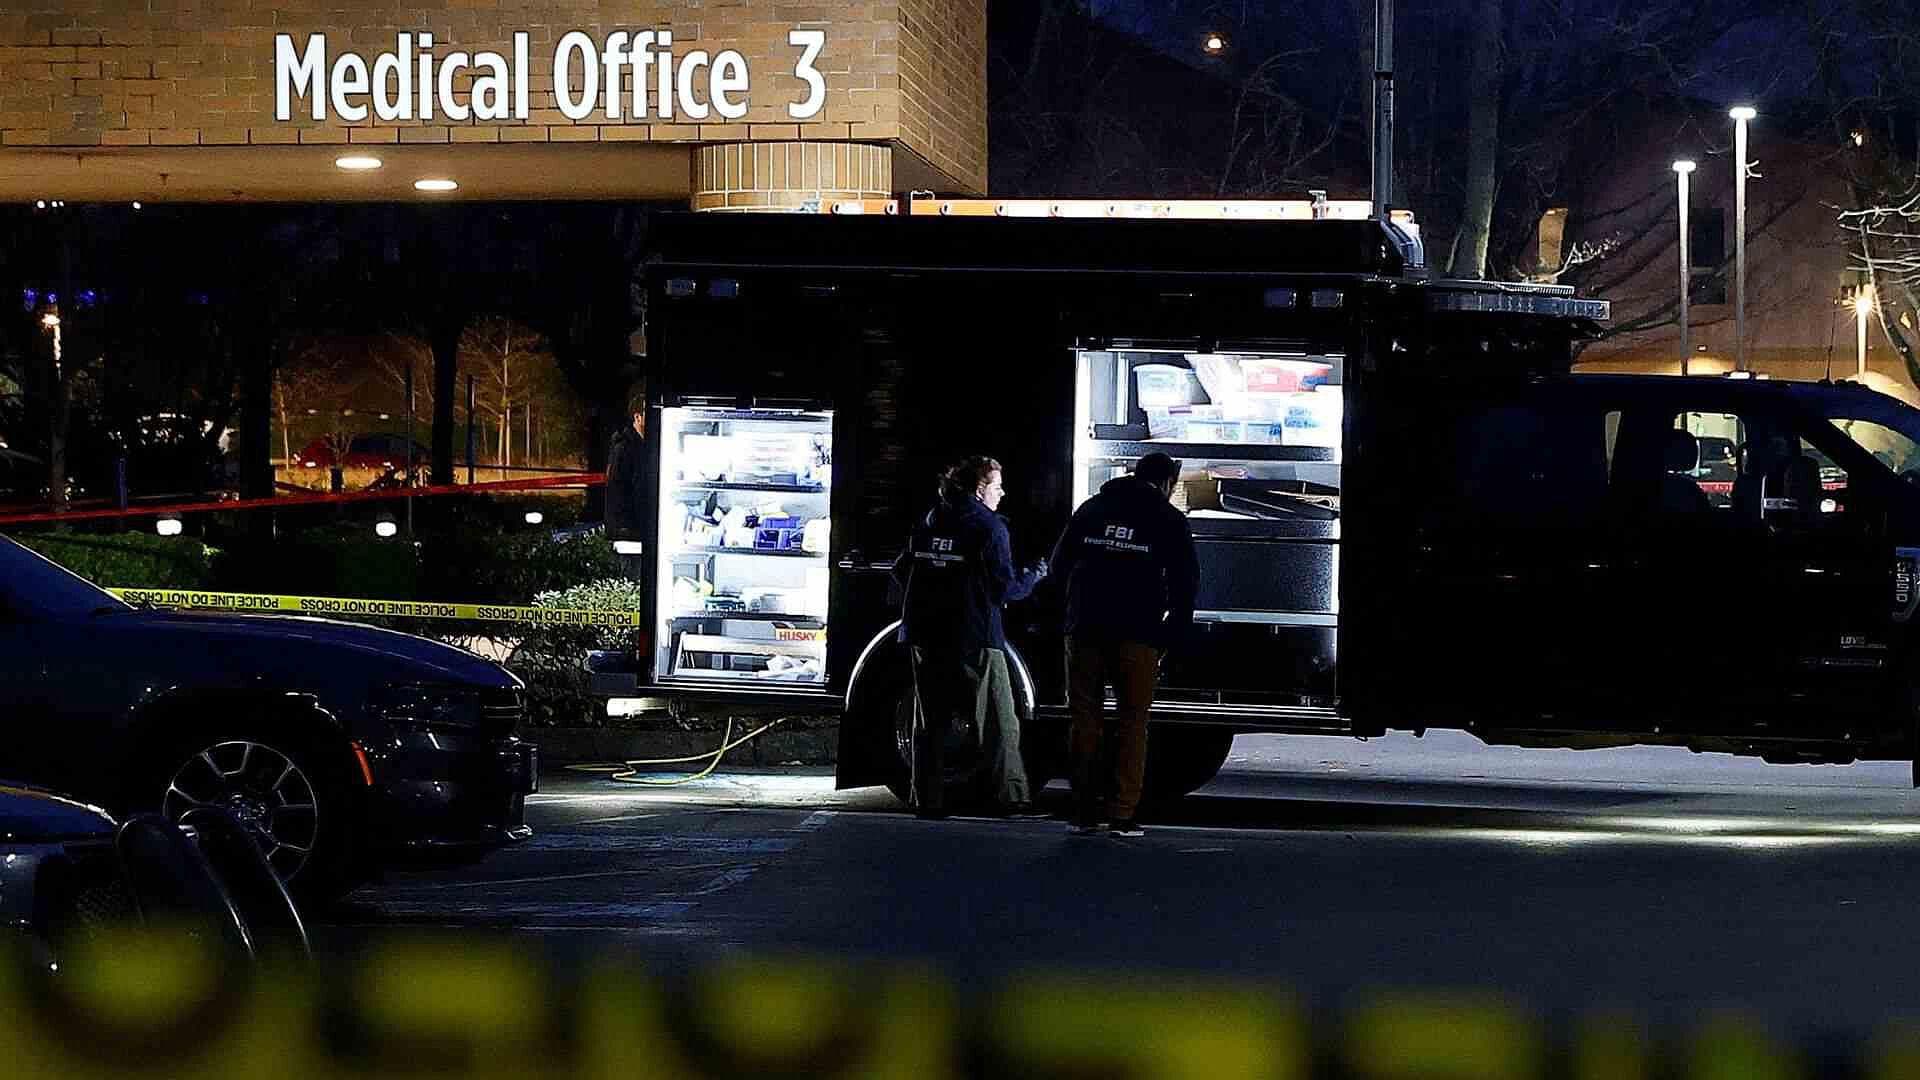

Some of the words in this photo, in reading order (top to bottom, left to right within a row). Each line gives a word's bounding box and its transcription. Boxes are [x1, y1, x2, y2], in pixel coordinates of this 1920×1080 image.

[274, 31, 529, 121] Medical
[553, 30, 749, 120] Office
[787, 30, 827, 119] 3
[1104, 525, 1134, 540] FBI
[932, 537, 953, 551] FBI
[123, 590, 163, 603] CROSS
[165, 592, 188, 604] NOT
[191, 593, 209, 605] DO
[209, 594, 235, 607] LINE
[237, 595, 279, 608] POLICE
[301, 598, 341, 611] CROSS
[342, 600, 366, 613] NOT
[368, 602, 385, 614] DO
[387, 603, 412, 615] LINE
[415, 605, 456, 617] POLICE
[478, 607, 517, 620] CROSS
[520, 609, 543, 622] NOT
[545, 610, 562, 623] DO
[564, 611, 589, 624] LINE
[591, 612, 632, 625] POLICE
[779, 631, 817, 641] HUSKY
